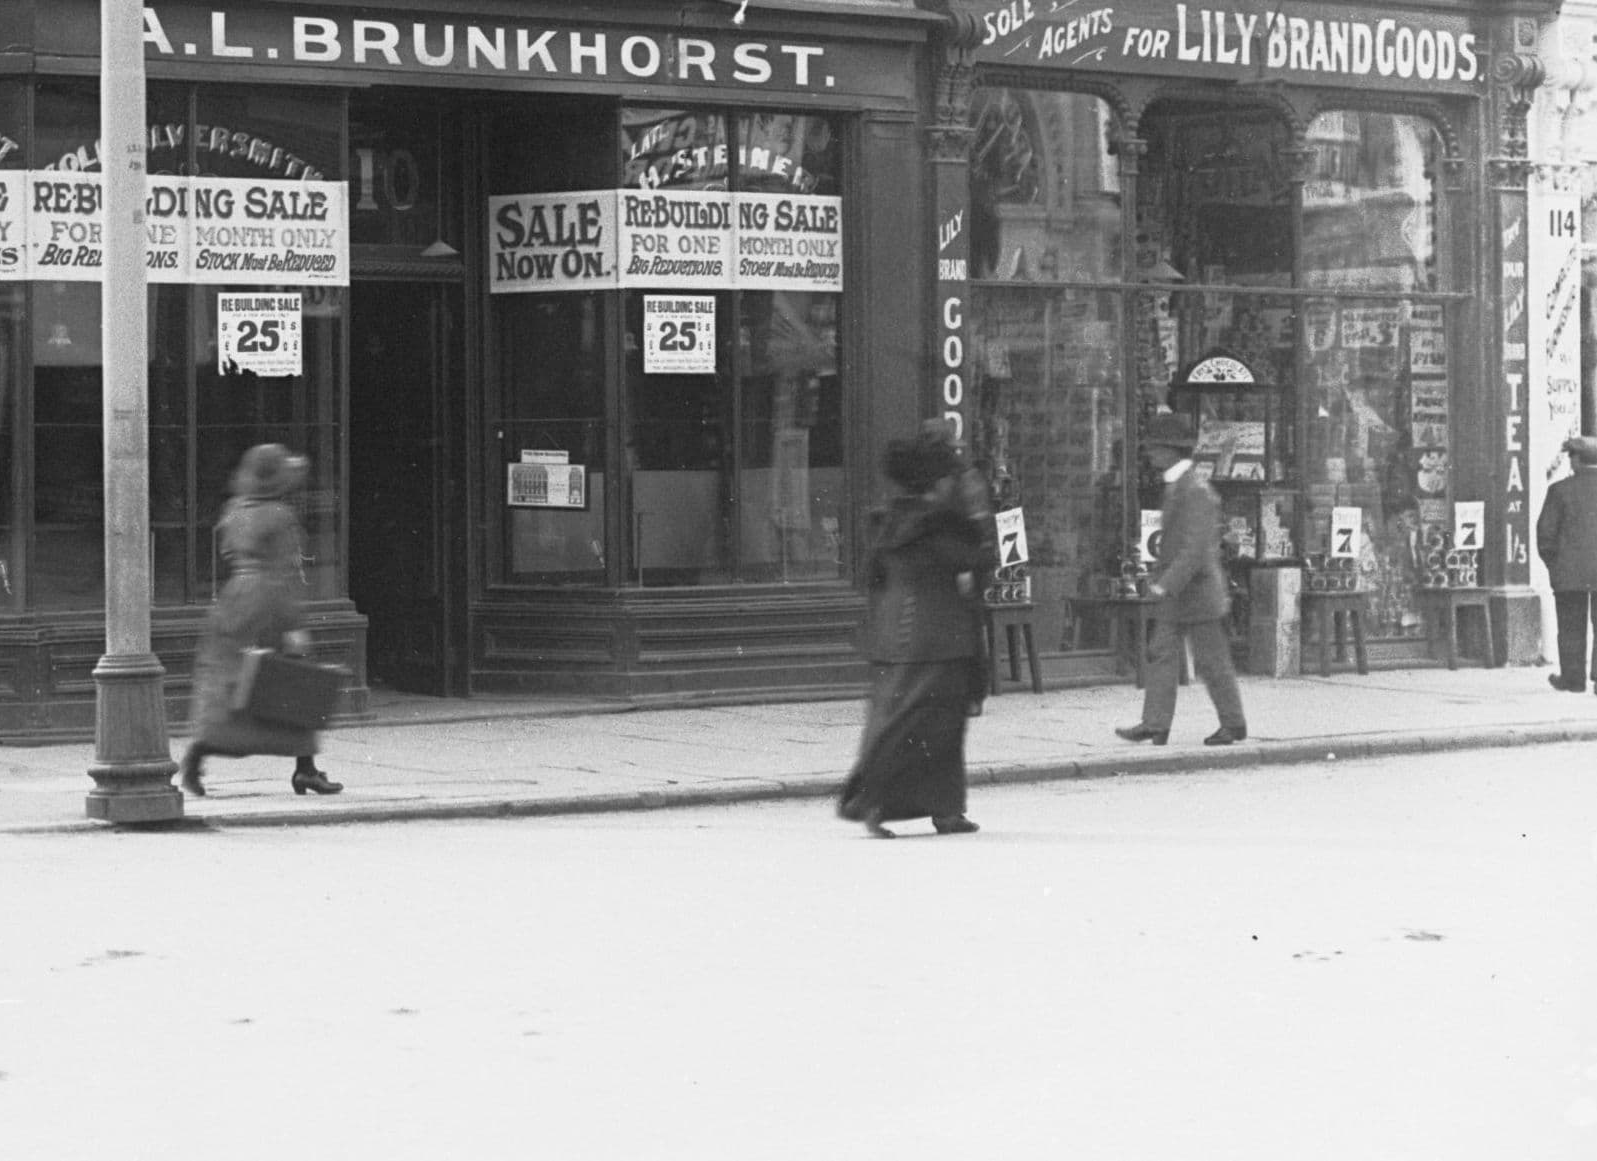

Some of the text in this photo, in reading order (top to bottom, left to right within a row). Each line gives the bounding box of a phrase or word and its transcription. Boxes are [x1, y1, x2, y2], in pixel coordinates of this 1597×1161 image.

[1038, 2, 1485, 83] AGENTS FOR LILY BRAND GOODS.
[243, 187, 328, 222] SALE
[774, 200, 839, 234] SALE
[49, 221, 337, 250] FOR NE MONTH ONLY
[495, 199, 604, 250] SALE
[938, 208, 964, 252] LILY
[1549, 209, 1577, 238] 114
[37, 243, 73, 267] BIG
[196, 248, 240, 272] STOCK
[282, 249, 337, 273] REDUCED
[630, 234, 839, 258] FOR ONE MONTH ONLY
[495, 248, 612, 282] NOW ON.
[626, 255, 648, 275] BIG
[938, 259, 967, 281] BRAND
[277, 297, 301, 312] SALE
[694, 300, 714, 314] SALE
[236, 319, 281, 353] 25
[659, 321, 697, 352] 25
[943, 296, 964, 442] GOOD
[1507, 500, 1523, 513] AT
